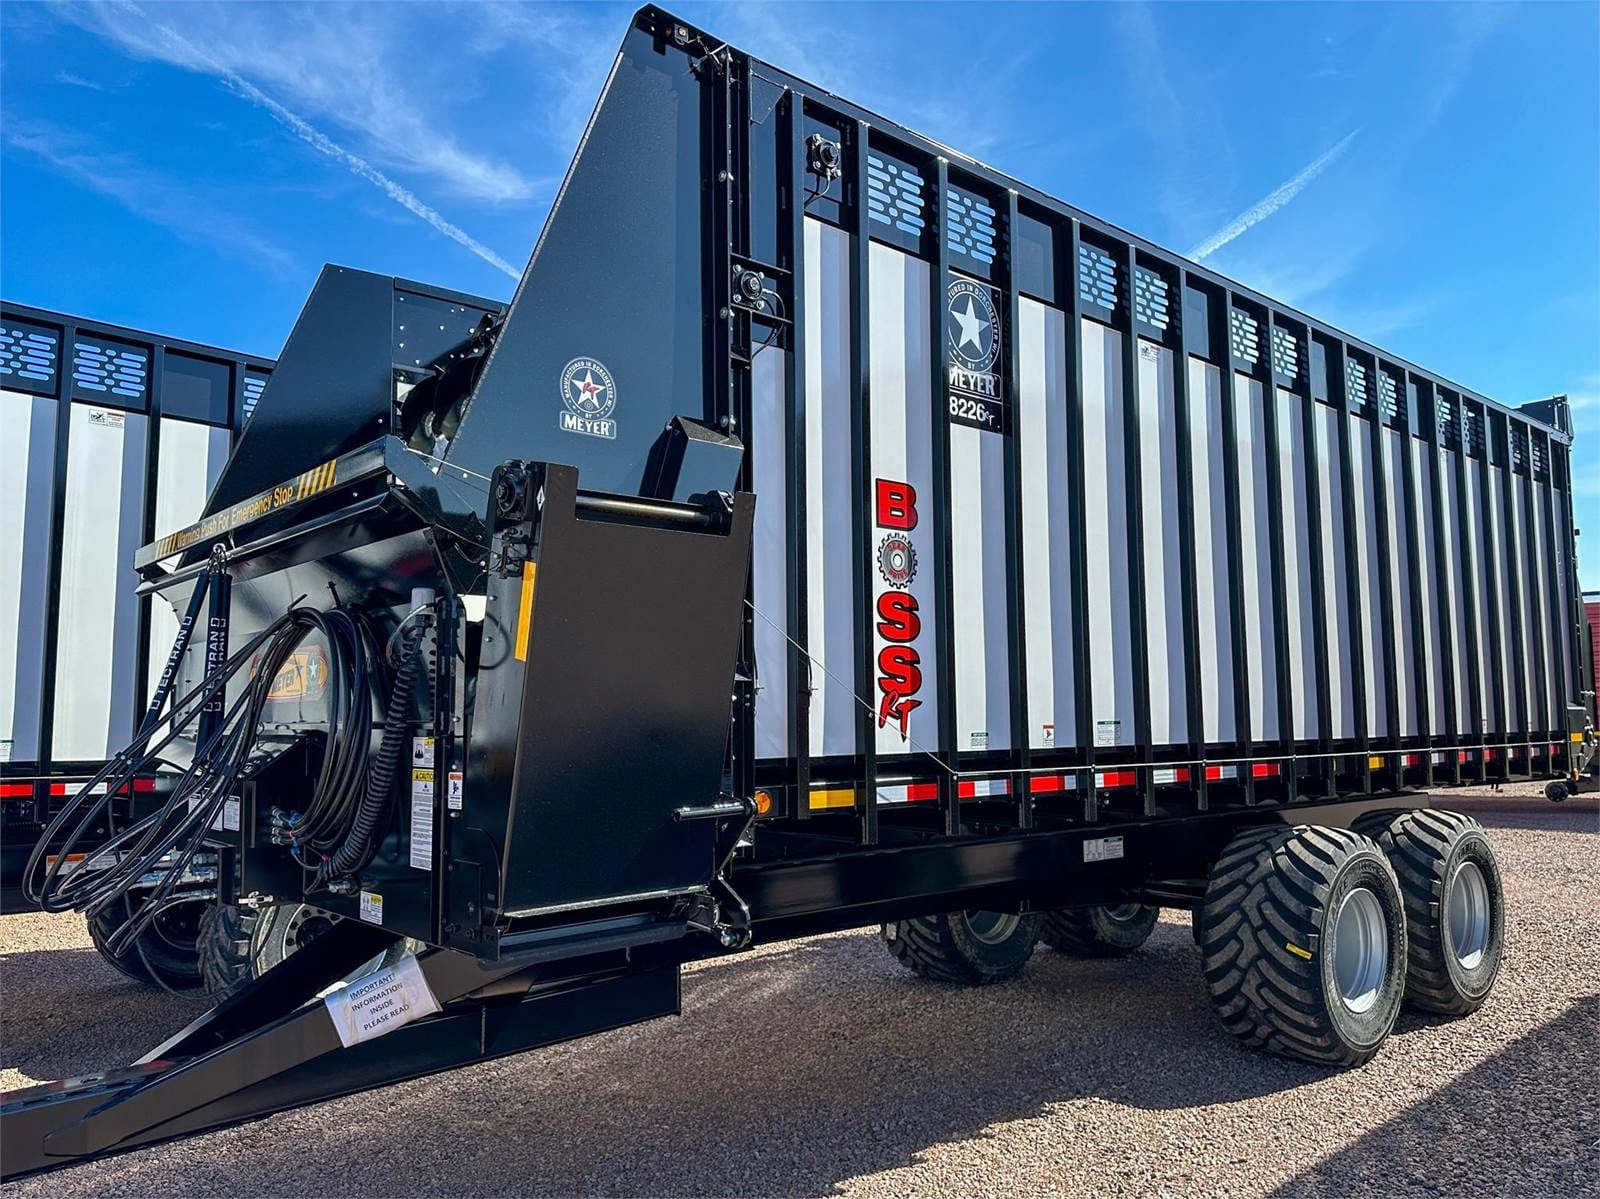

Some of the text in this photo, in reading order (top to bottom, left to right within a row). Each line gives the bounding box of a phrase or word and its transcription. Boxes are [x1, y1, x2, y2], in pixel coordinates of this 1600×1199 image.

[564, 414, 609, 436] MEYER
[200, 518, 217, 537] Push
[217, 514, 230, 531] For
[231, 493, 273, 523] Emergency
[273, 486, 293, 507] Stop
[351, 982, 404, 1012] INFORMATION
[369, 998, 394, 1015] INSIDE
[363, 1004, 410, 1031] PLEASE READ
